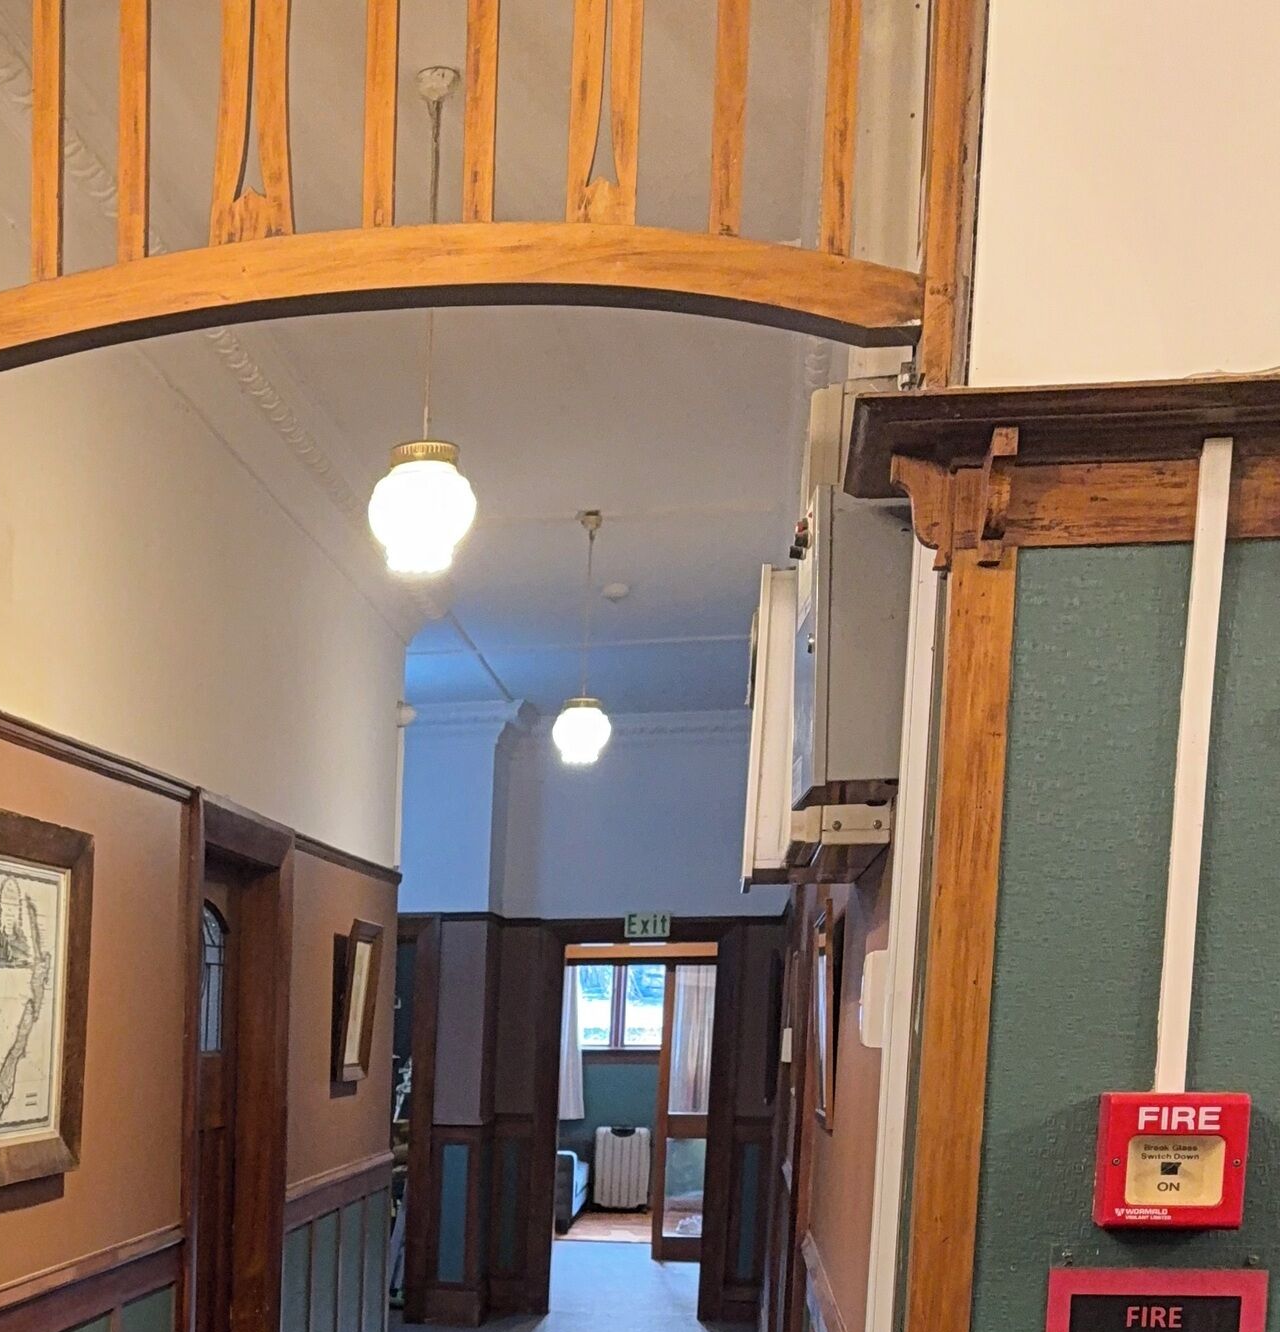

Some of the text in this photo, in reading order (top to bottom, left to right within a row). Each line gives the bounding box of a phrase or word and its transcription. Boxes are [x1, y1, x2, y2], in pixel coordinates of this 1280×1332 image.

[627, 914, 668, 935] Exit
[1138, 1106, 1222, 1131] FIRE
[1157, 1182, 1180, 1192] ON
[1125, 1306, 1182, 1329] FIRE
